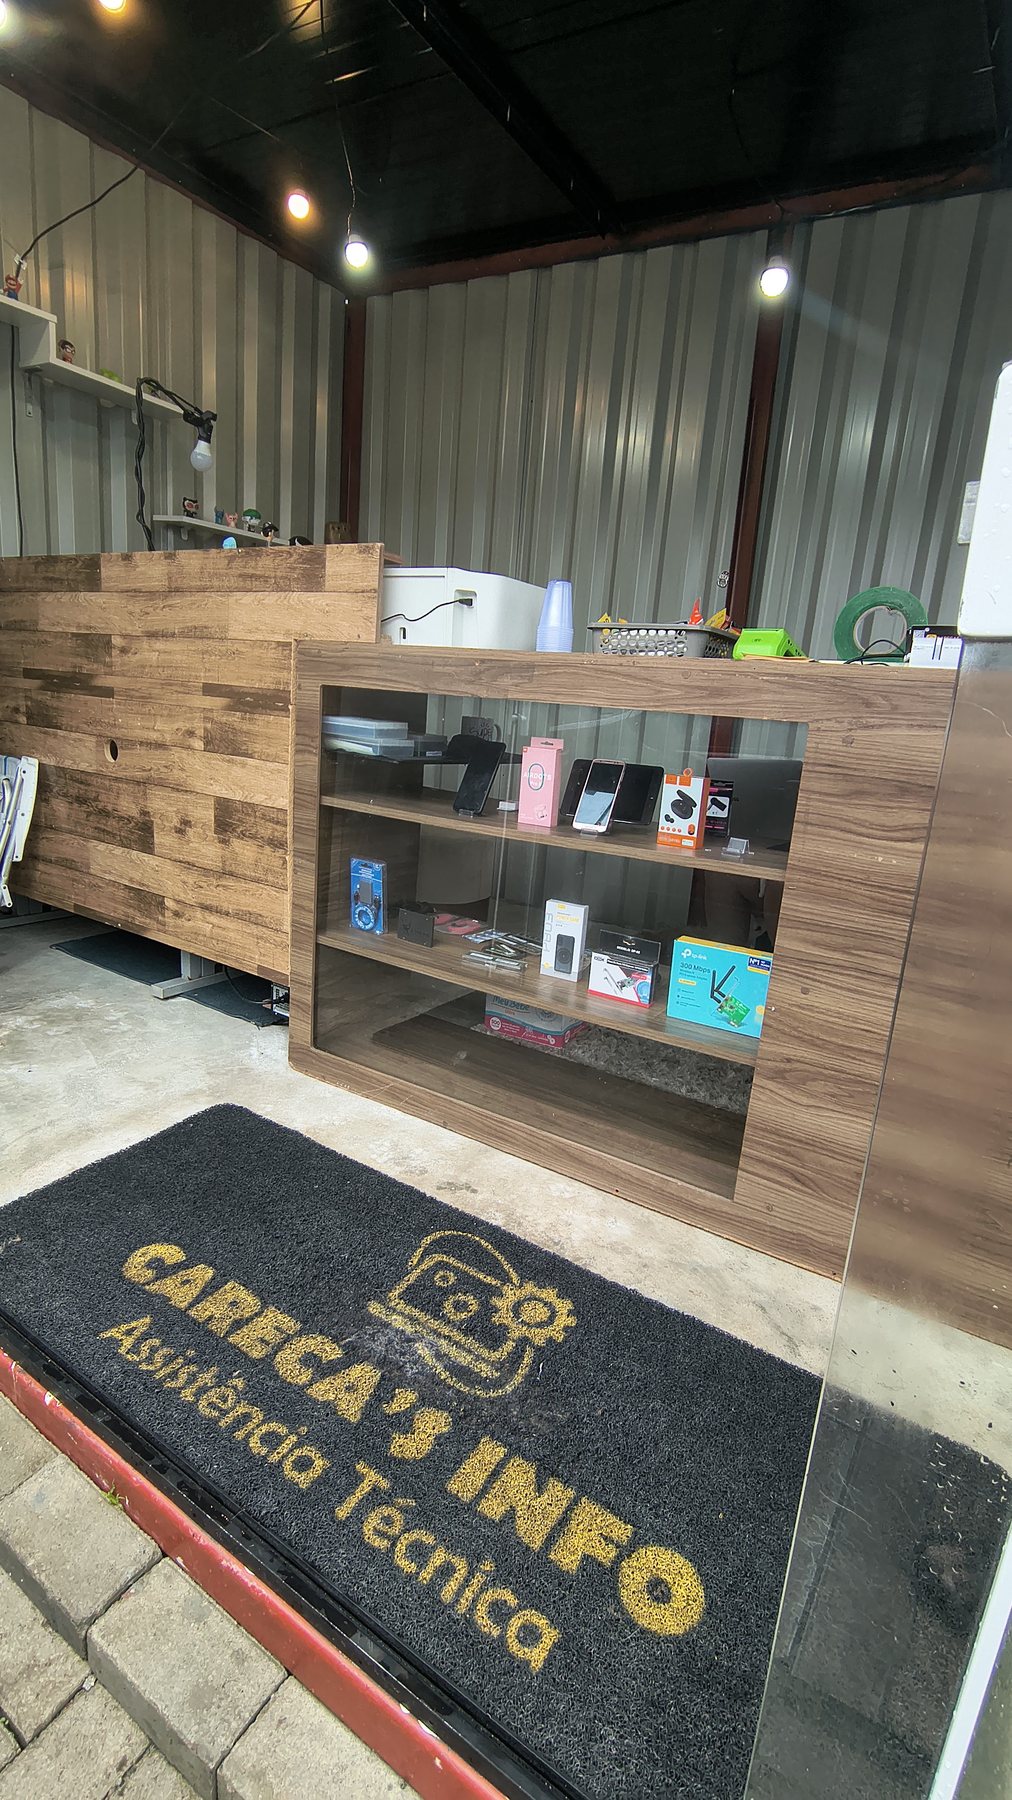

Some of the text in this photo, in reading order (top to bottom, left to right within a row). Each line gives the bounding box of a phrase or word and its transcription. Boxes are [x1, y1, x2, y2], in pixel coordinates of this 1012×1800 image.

[693, 964, 711, 974] Mbps
[98, 1315, 560, 1672] Assistência Técnica
[121, 1242, 705, 1637] CARECA'S INFO
